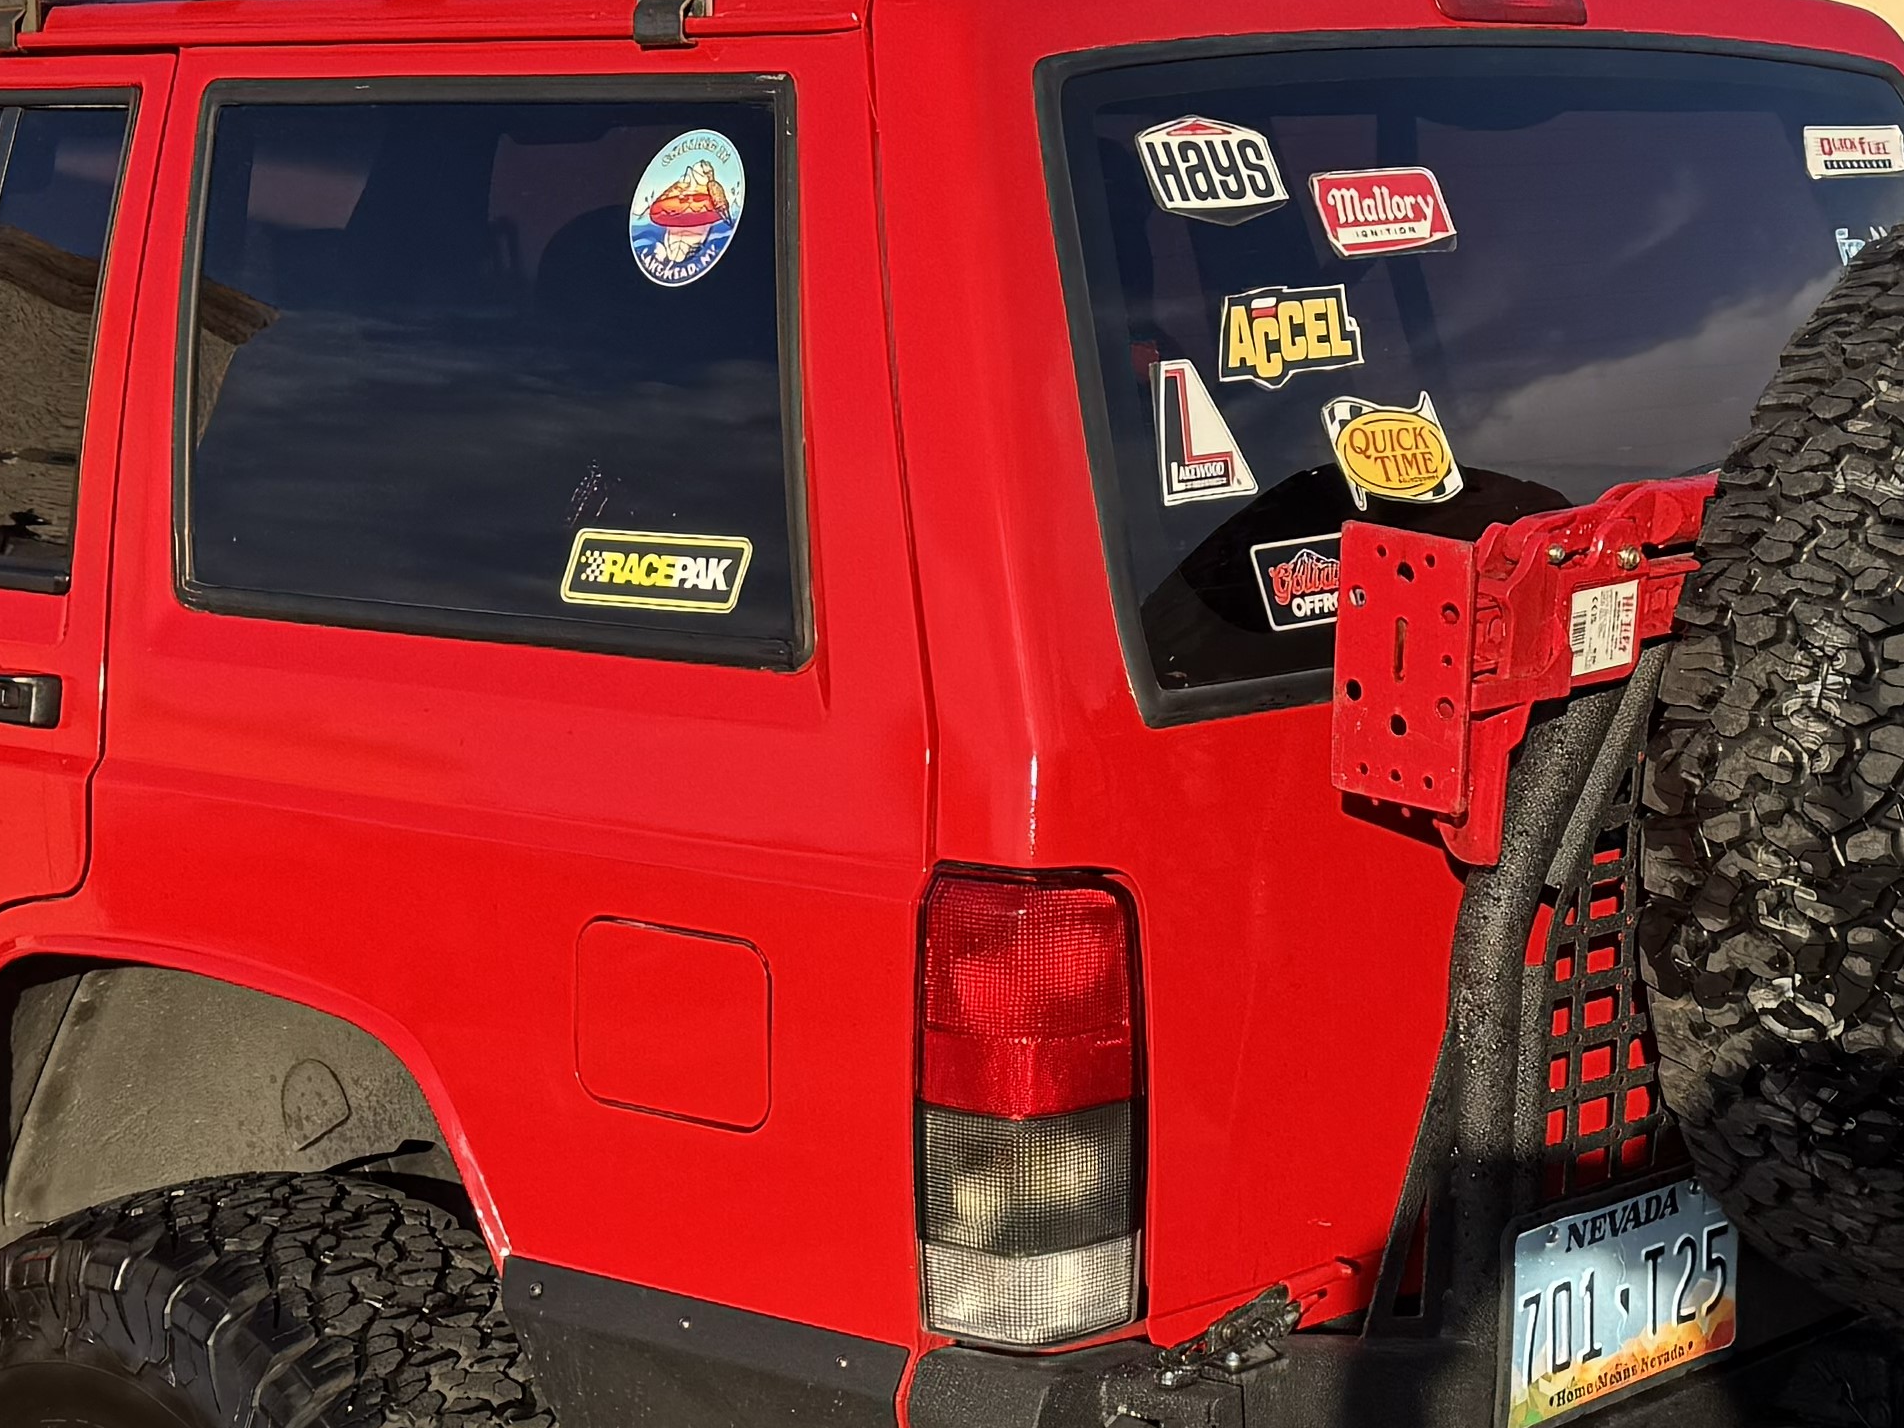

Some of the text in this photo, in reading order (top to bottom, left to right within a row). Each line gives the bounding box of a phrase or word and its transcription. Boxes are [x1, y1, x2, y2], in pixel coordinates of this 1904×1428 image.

[1327, 185, 1434, 225] Mallory
[1354, 225, 1417, 239] IGNITION
[1228, 297, 1352, 378] ACCEL
[1348, 427, 1429, 459] QUICK
[1374, 451, 1438, 483] TIME
[597, 551, 732, 591] RACEPAK
[1565, 1187, 1679, 1252] NEVADA
[1518, 1222, 1729, 1389] 701 T25
[1556, 1382, 1593, 1407] Home
[1640, 1344, 1684, 1374] Nevada
